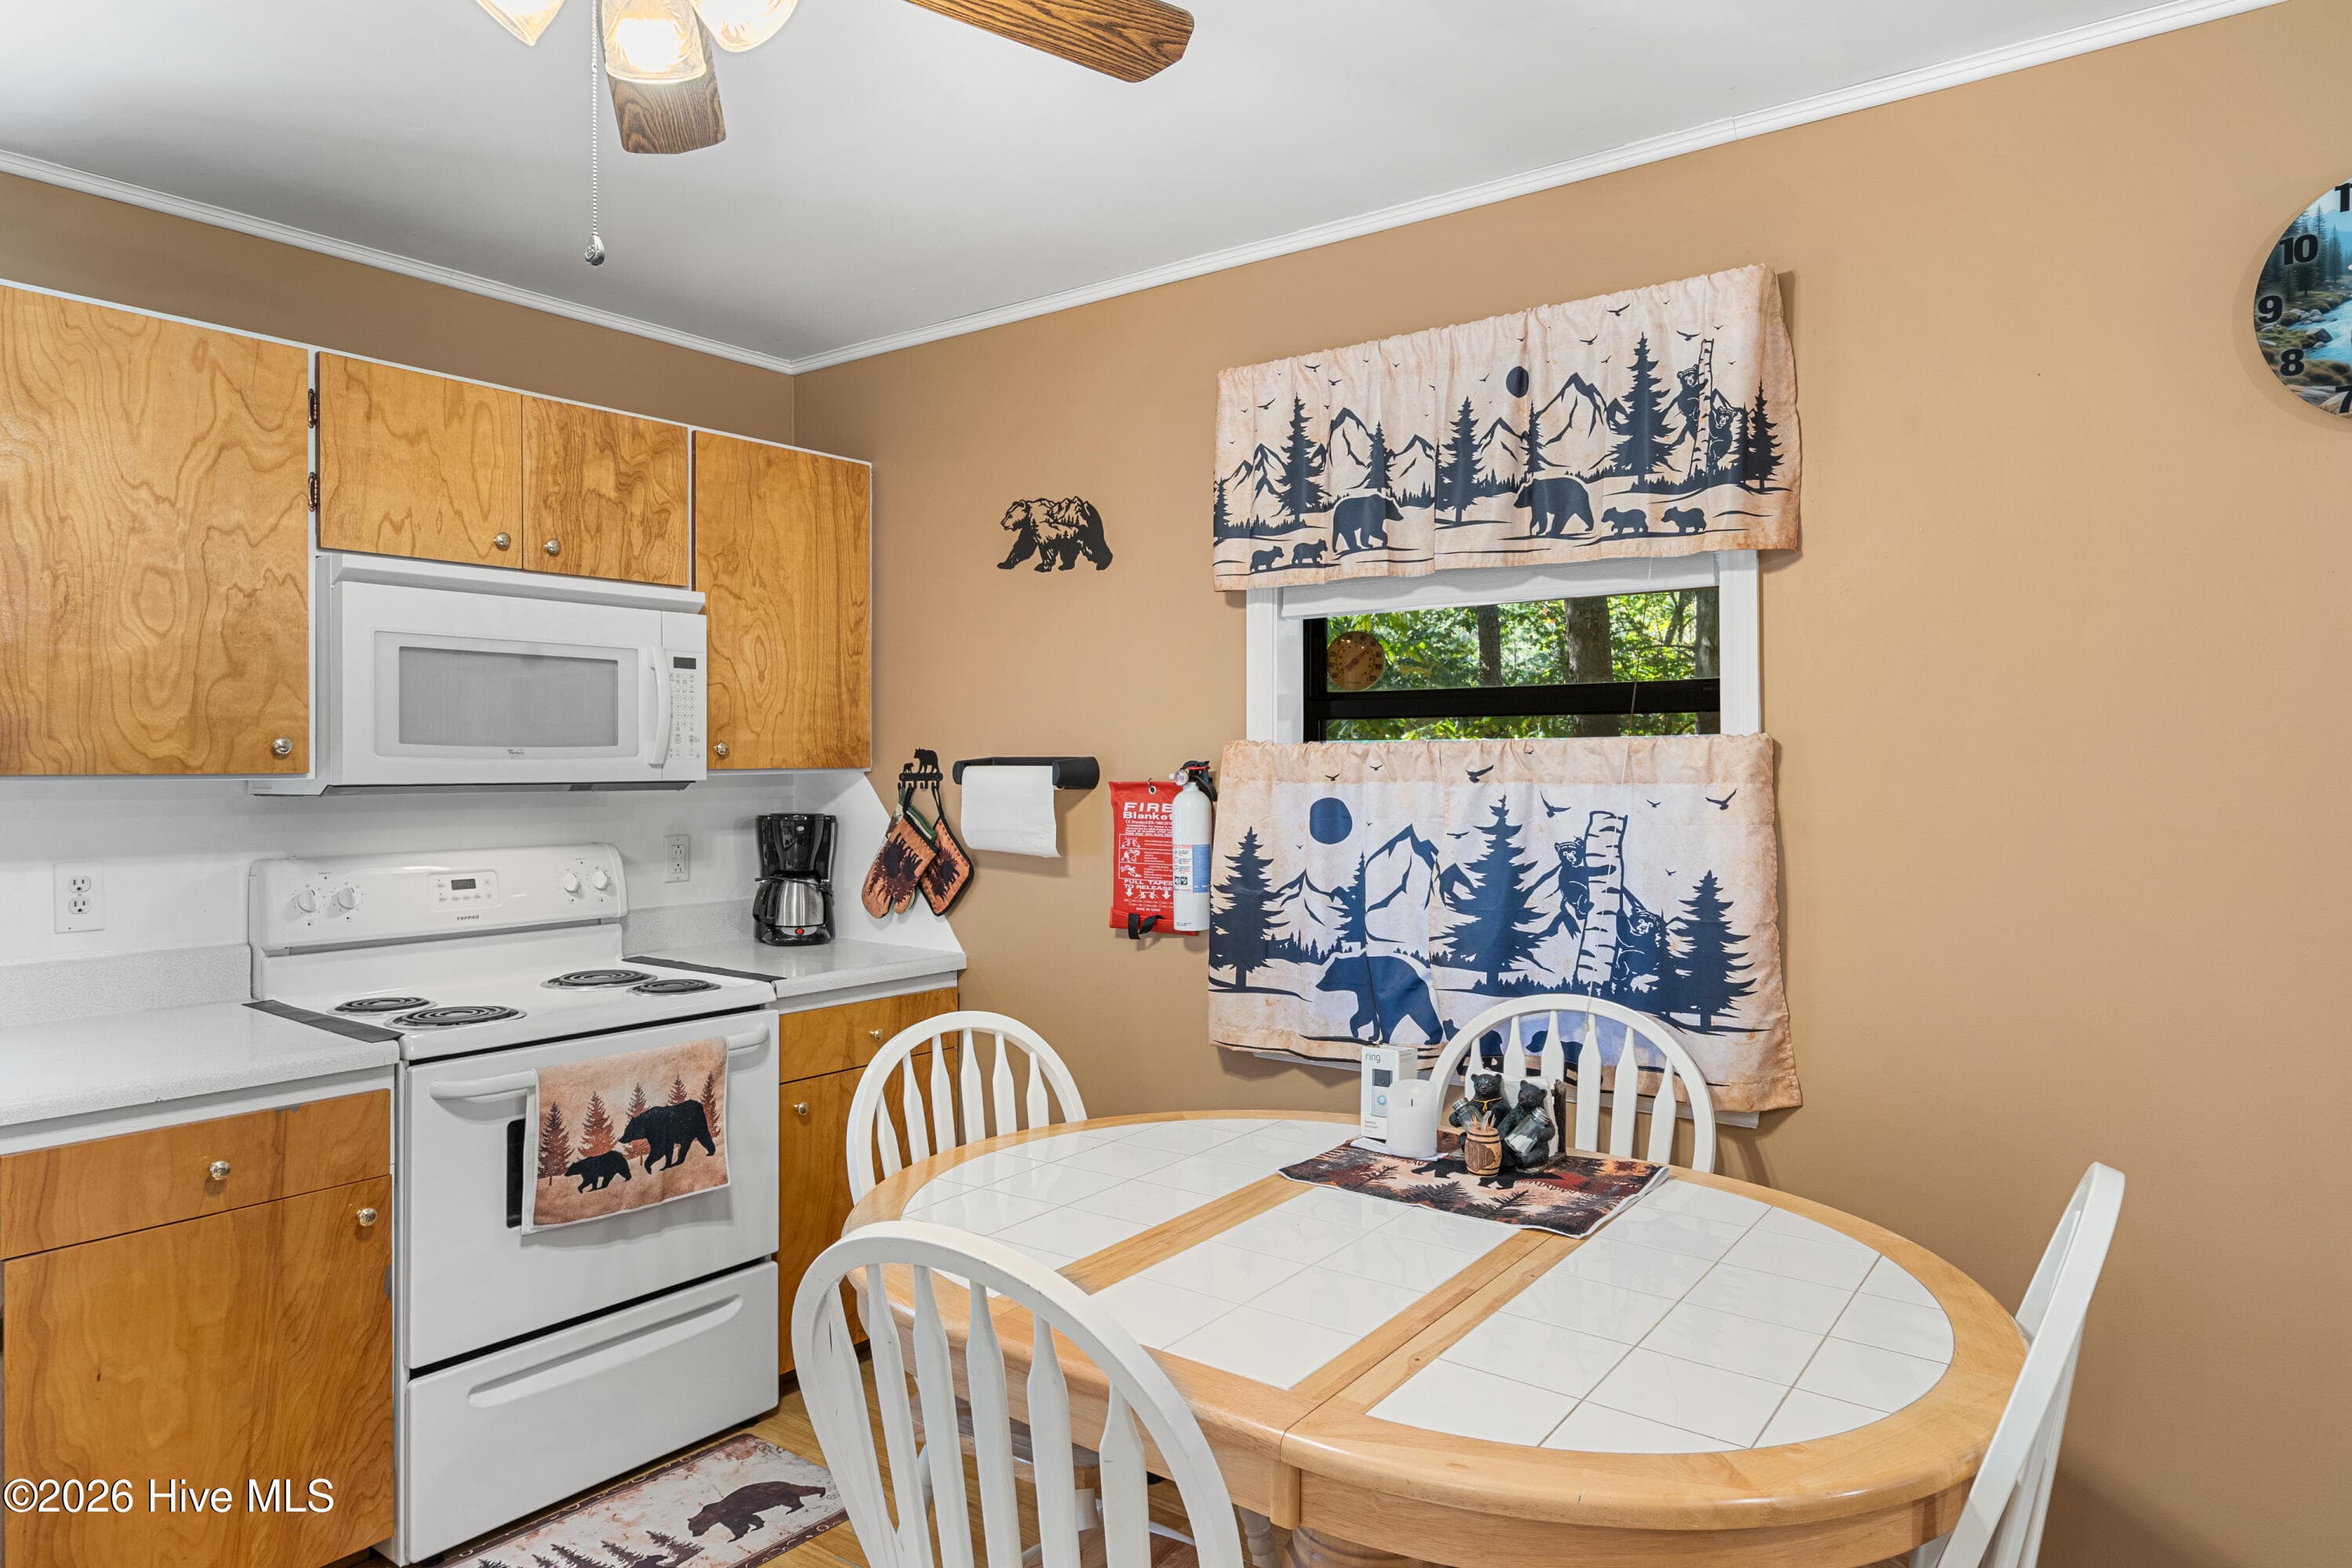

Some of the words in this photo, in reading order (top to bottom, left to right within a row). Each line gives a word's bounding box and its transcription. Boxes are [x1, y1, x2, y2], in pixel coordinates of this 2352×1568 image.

[2335, 183, 2352, 212] 1
[2280, 234, 2318, 265] 10
[2258, 295, 2282, 323] 9
[2280, 348, 2304, 376] 8
[2336, 385, 2352, 413] 7
[1123, 802, 1173, 812] FIRE
[1123, 811, 1173, 820] Blanket
[1365, 1052, 1381, 1064] ring
